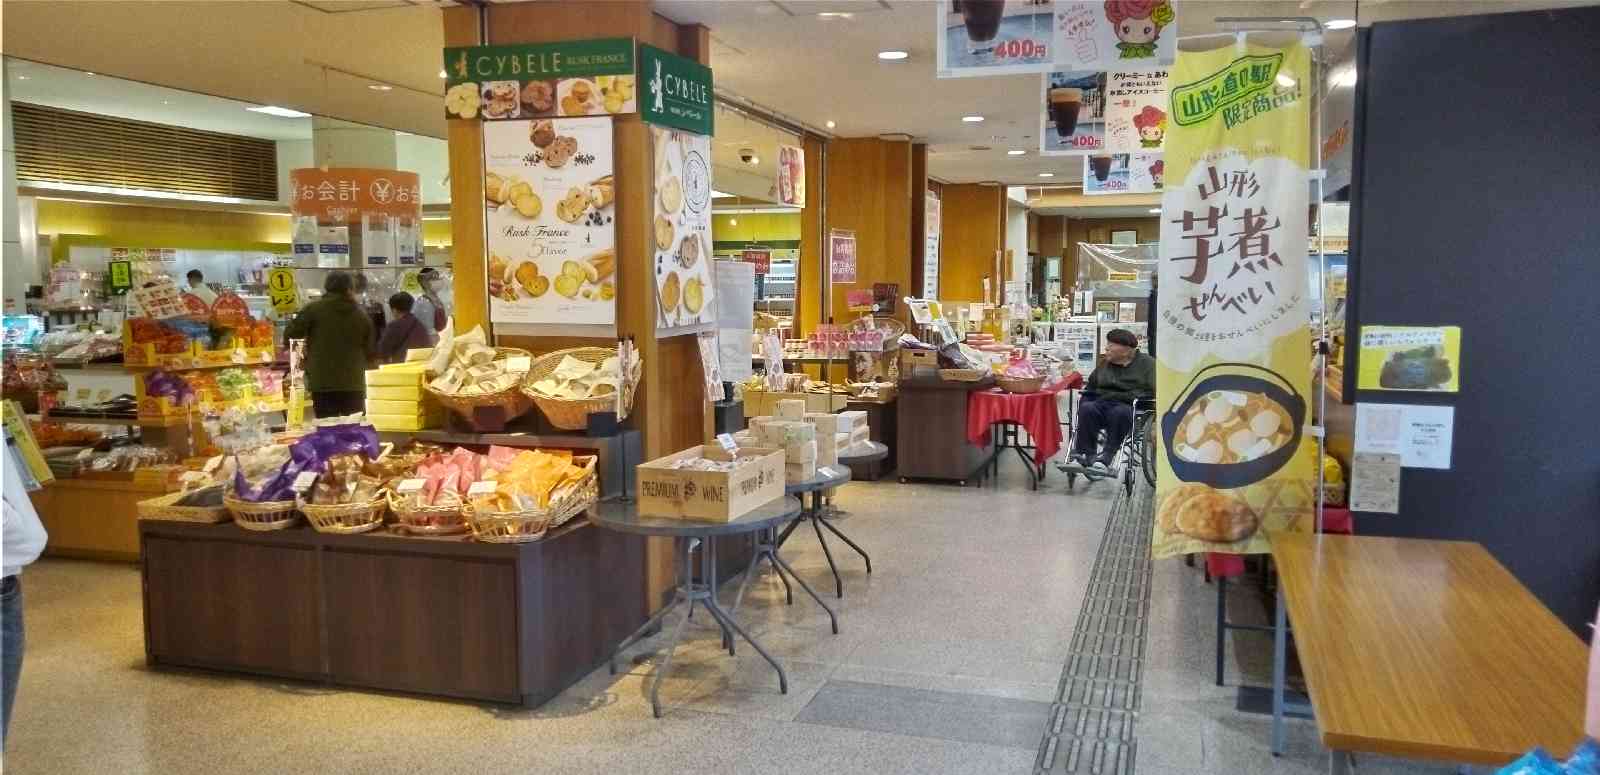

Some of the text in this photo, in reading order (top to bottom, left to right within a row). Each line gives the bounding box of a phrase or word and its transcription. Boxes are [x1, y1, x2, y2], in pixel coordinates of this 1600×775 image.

[995, 39, 1046, 58] 400円
[476, 52, 561, 76] CYBELE
[665, 73, 707, 104] CYBELE
[301, 180, 360, 201] お会計
[1198, 166, 1260, 200] 山形
[503, 225, 570, 239] Rusk France
[1170, 201, 1283, 284] 芋煮
[272, 295, 296, 306] レジ
[1182, 281, 1275, 321] せんべい
[641, 481, 724, 502] PREMIUM WINE
